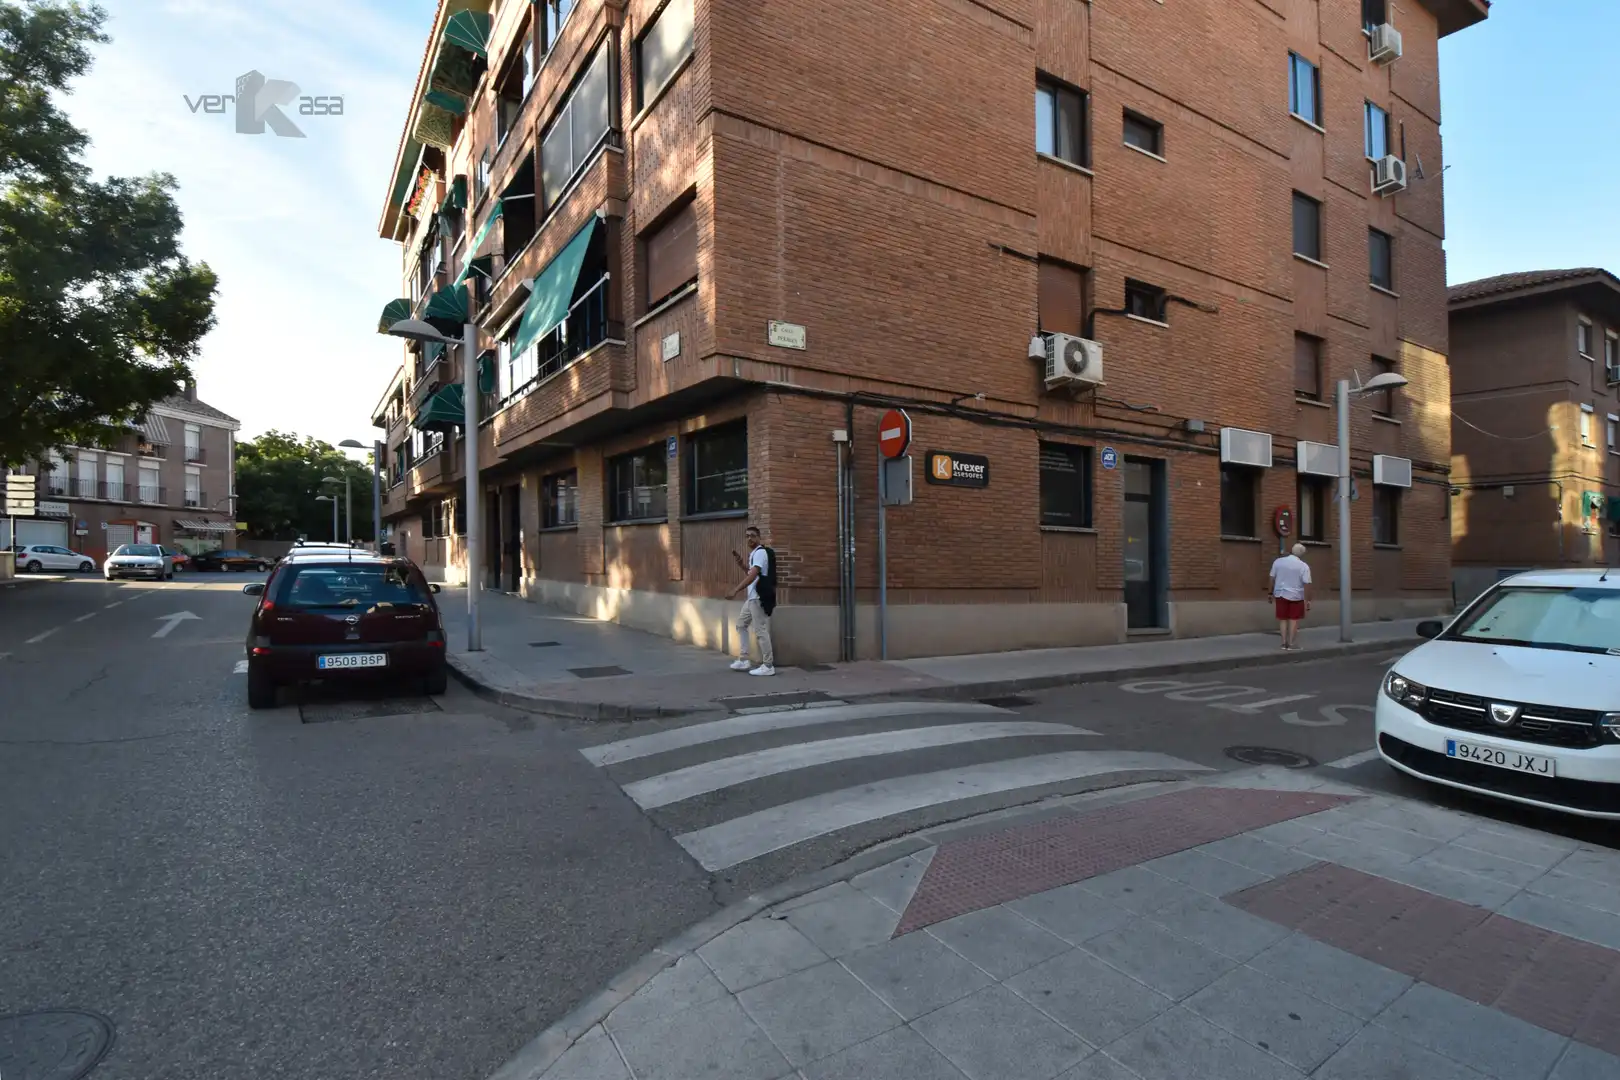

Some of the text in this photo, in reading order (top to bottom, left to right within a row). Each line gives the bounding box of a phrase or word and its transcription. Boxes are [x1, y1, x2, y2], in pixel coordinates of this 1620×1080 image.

[953, 460, 985, 473] Krexer
[953, 470, 984, 479] asesores
[327, 655, 384, 667] 9508 BSP
[1118, 680, 1375, 727] STOP
[1459, 744, 1549, 773] 9420 JXJ
